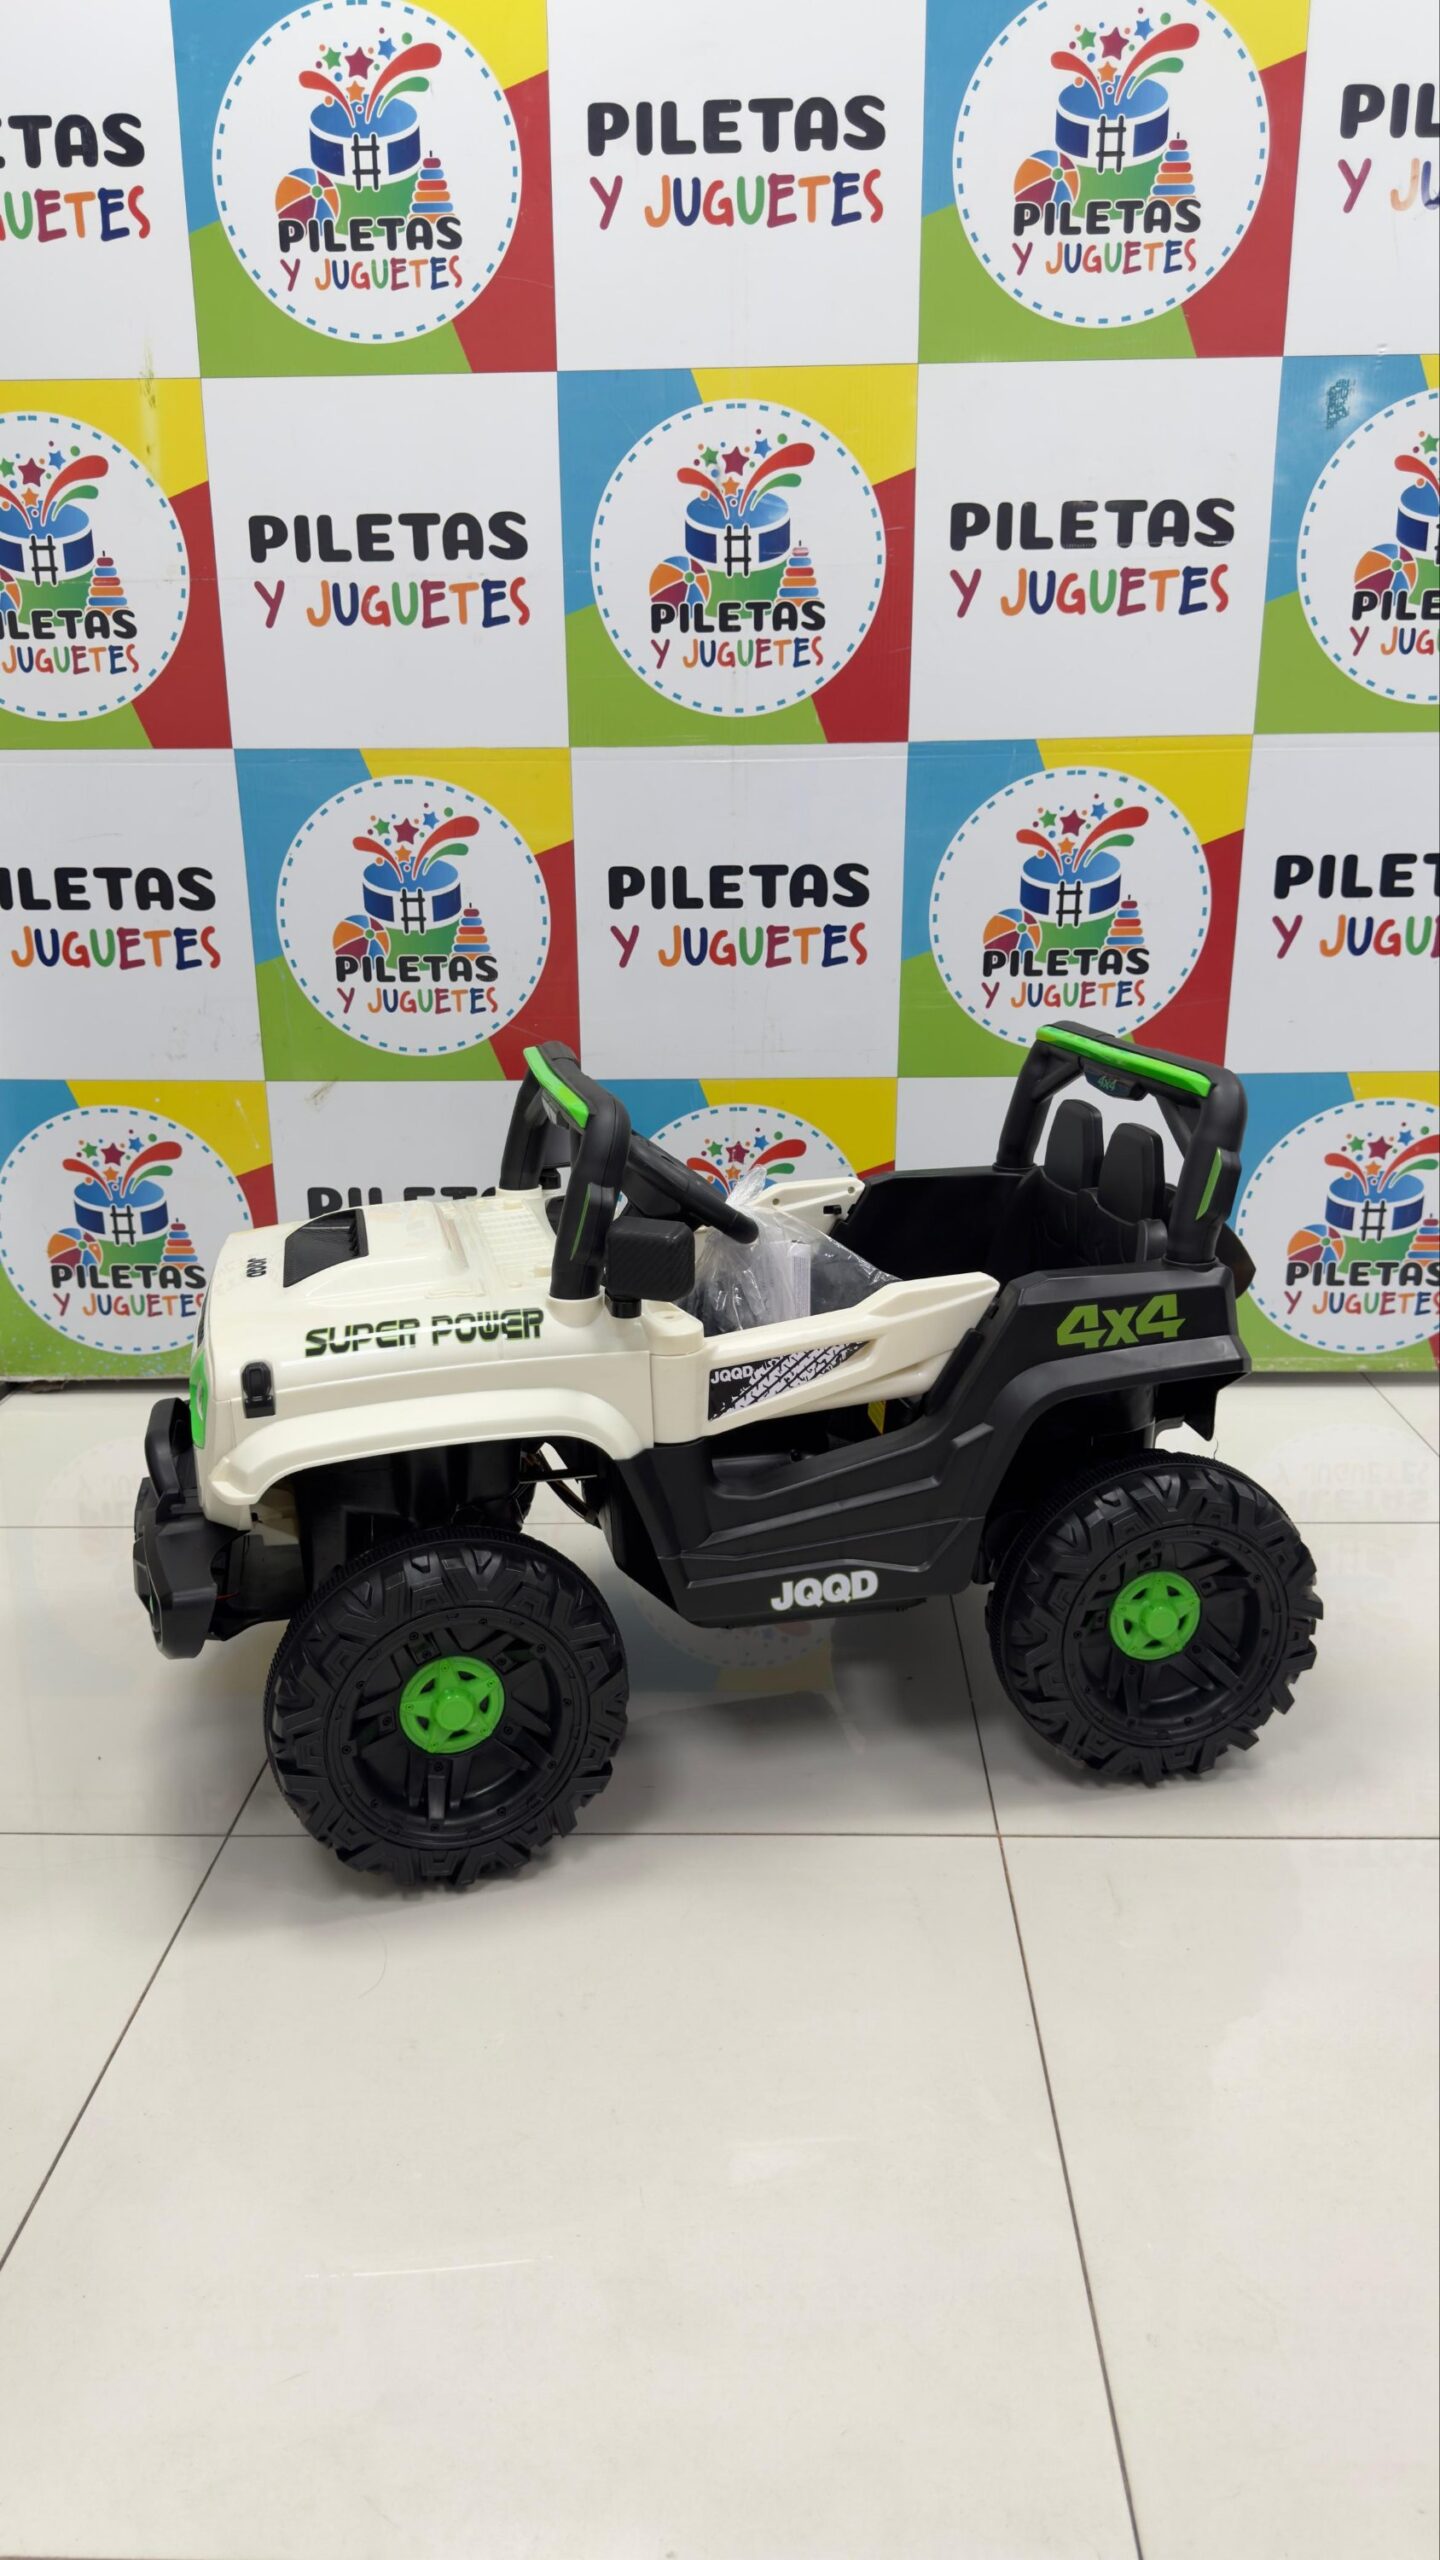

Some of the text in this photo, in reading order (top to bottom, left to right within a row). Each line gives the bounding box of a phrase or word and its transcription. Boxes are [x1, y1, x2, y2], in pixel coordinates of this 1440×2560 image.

[0, 113, 145, 169] TAS
[587, 95, 886, 157] PILETAS
[589, 168, 885, 231] Y JUGUETES
[1338, 157, 1372, 213] Y
[0, 184, 151, 242] UETES
[1014, 199, 1201, 236] PILETAS
[278, 216, 462, 253] PILETAS
[279, 254, 464, 292] Y JUGUETES
[1011, 238, 1197, 276] Y JUGUETES
[248, 511, 528, 563] PILETAS
[950, 498, 1235, 551] PILETAS
[255, 575, 530, 629] Y JUGUETES
[950, 563, 1230, 618] Y JUGUETES
[650, 600, 826, 634] PILETAS
[1, 643, 141, 676] JUGUETES
[650, 635, 825, 669] Y JUGUETES
[1349, 624, 1439, 656] Y JUG
[608, 862, 870, 910] PILETAS
[10, 925, 222, 971] JUGUETES
[610, 921, 869, 969] Y JUGUETES
[1273, 915, 1303, 959] Y
[335, 955, 499, 983] PILETAS
[982, 947, 1150, 978] PILETAS
[336, 986, 498, 1015] Y JUGUETES
[980, 979, 1146, 1009] Y JUGUETES
[50, 1264, 207, 1289] PILETAS
[53, 1292, 71, 1317] Y
[1056, 1293, 1186, 1350] 4x4
[1284, 1290, 1302, 1315] Y
[304, 1306, 545, 1358] SUPER POWER
[710, 1365, 754, 1384] JQQD
[770, 1570, 879, 1612] JQQD
